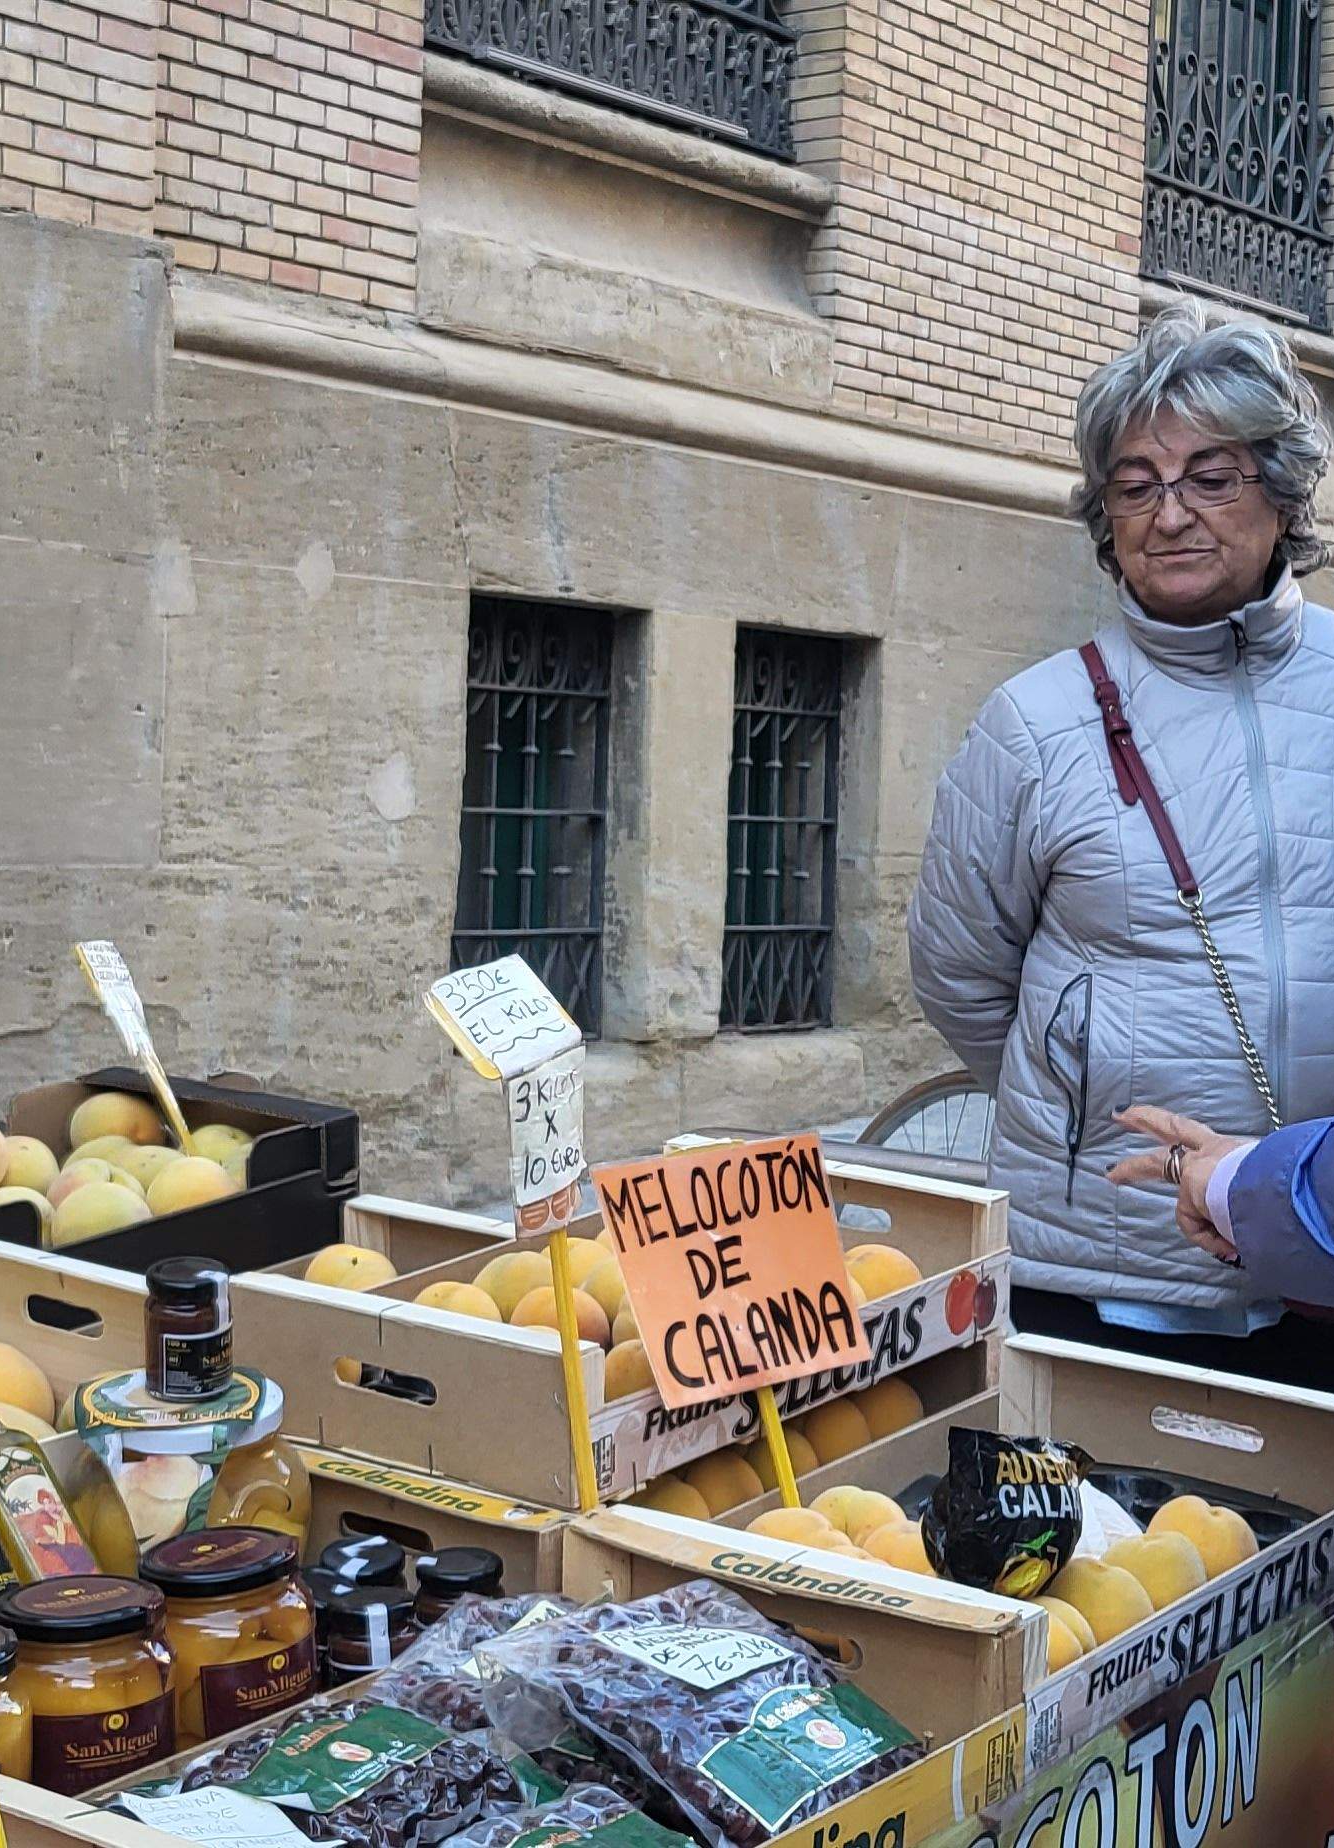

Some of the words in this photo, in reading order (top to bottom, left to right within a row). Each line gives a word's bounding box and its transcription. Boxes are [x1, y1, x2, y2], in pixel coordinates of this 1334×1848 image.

[467, 1017, 504, 1045] EL
[514, 1080, 531, 1123] 3
[522, 1151, 547, 1191] 10
[600, 1141, 830, 1254] MELOCOTÓN
[684, 1235, 752, 1301] DE
[664, 1281, 858, 1389] CALANDA
[1085, 1625, 1168, 1707] FRUTAS
[1166, 1527, 1334, 1688] SELECTAS
[651, 1648, 680, 1666] DE
[206, 1807, 238, 1820] DE
